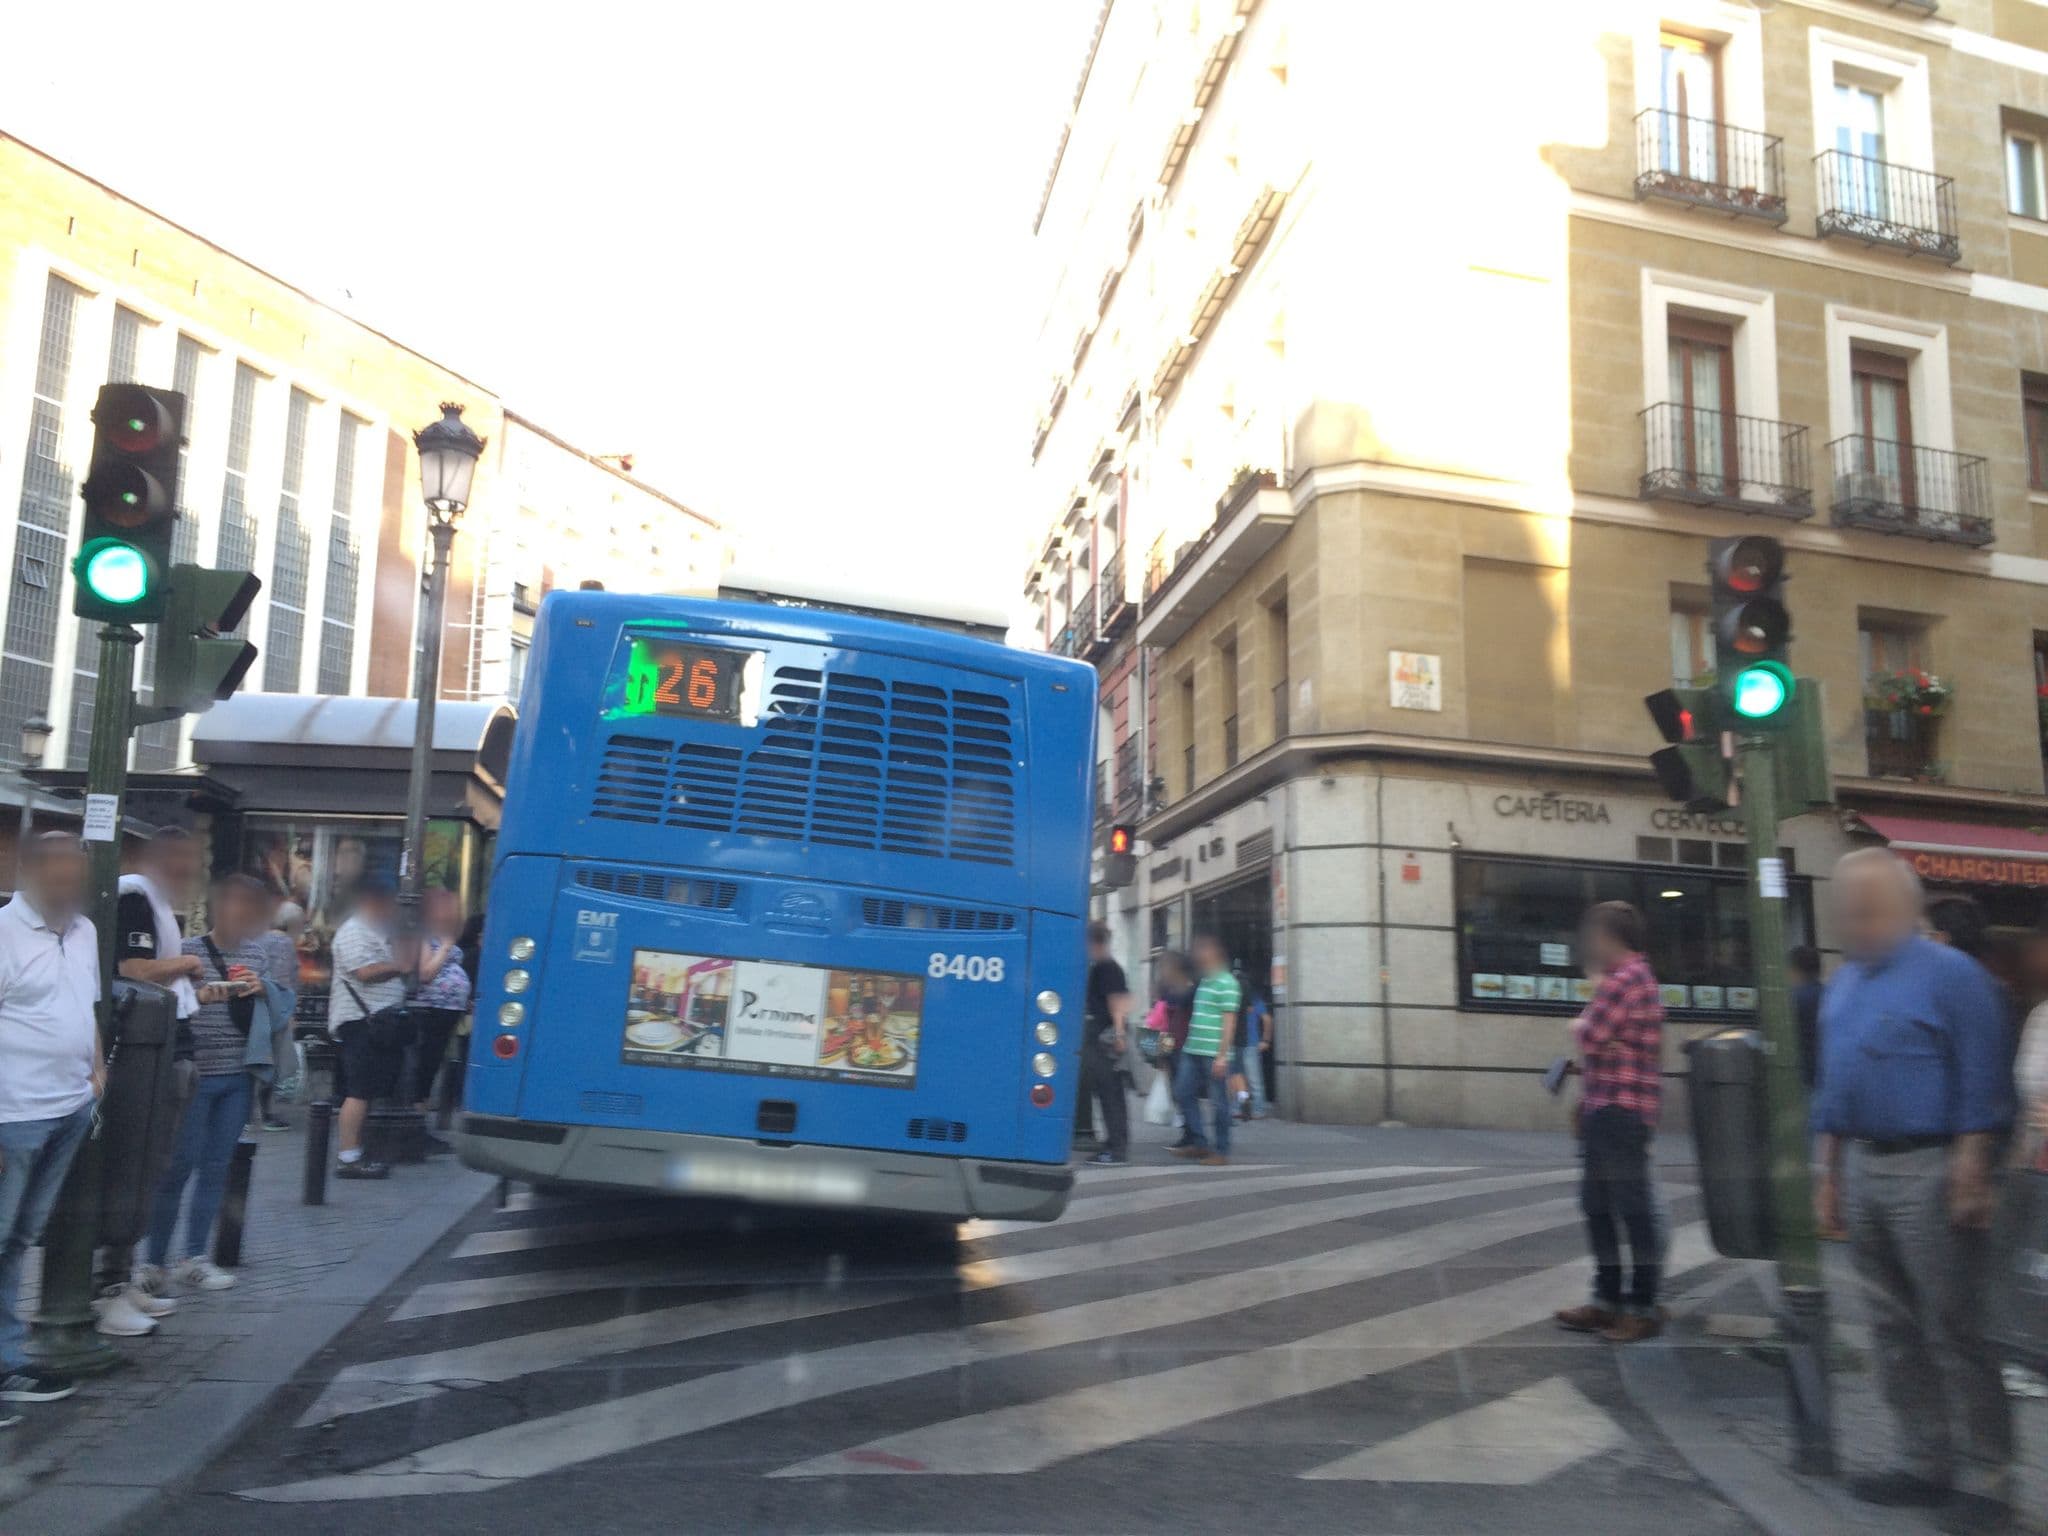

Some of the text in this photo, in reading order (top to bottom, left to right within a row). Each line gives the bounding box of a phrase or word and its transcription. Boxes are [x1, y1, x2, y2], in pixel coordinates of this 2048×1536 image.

[654, 654, 718, 709] 26
[576, 909, 620, 928] EMT
[927, 952, 1005, 982] 8408
